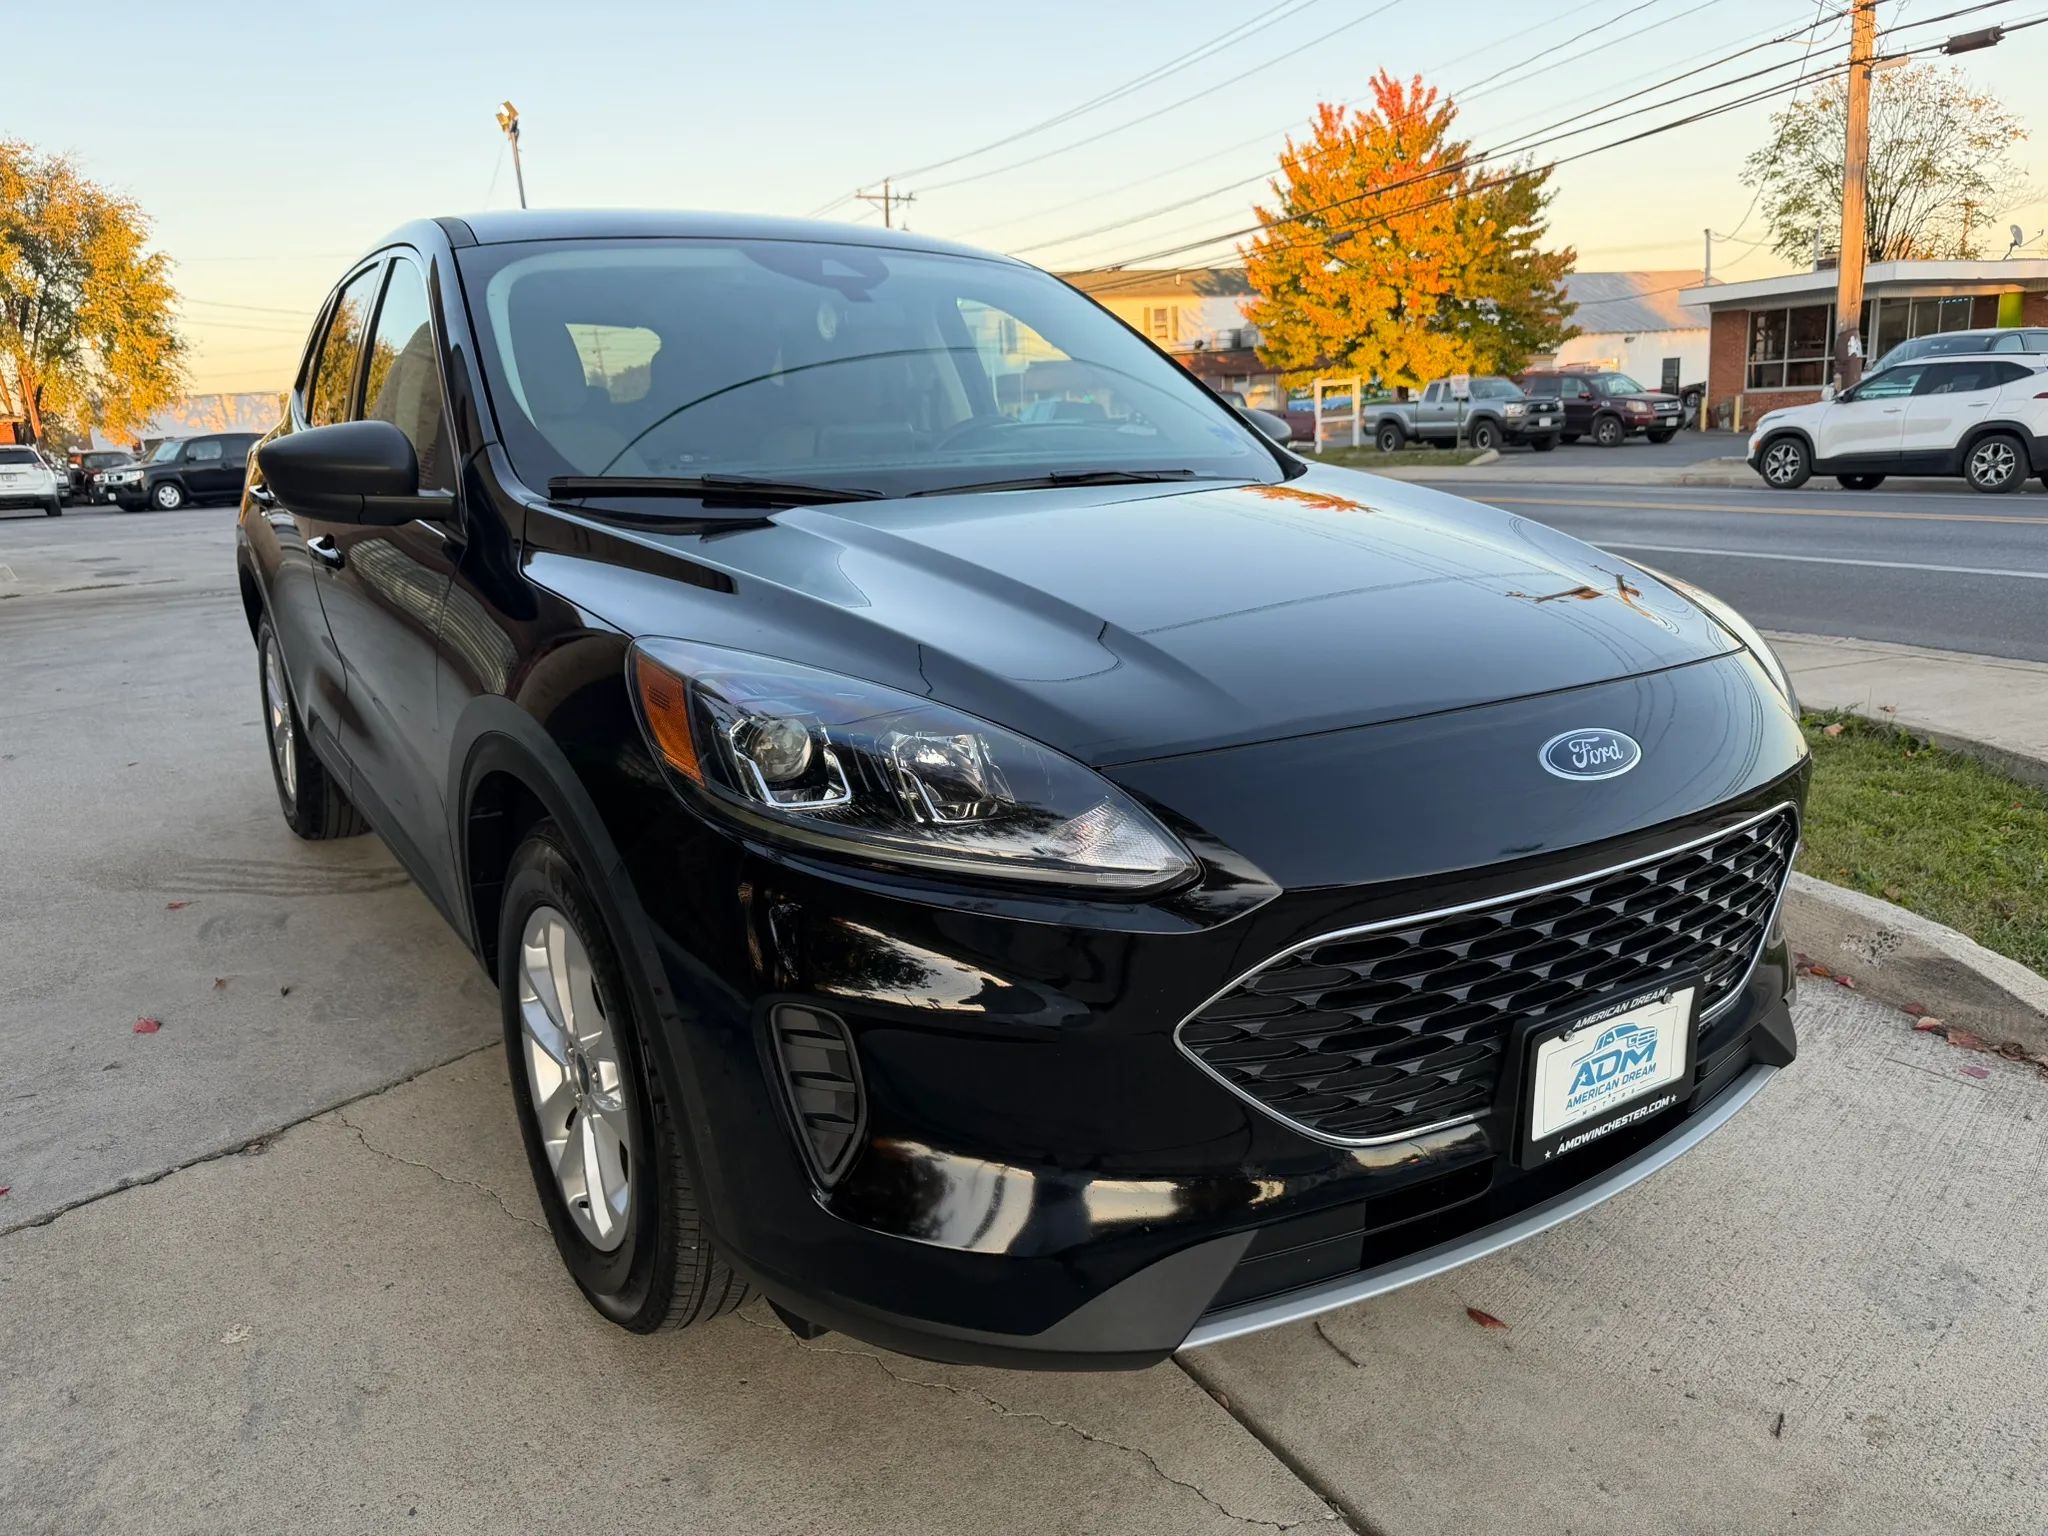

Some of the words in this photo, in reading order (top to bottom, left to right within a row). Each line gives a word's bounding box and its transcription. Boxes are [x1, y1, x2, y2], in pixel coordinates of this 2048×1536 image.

[1568, 736, 1624, 769] Ford
[1572, 1001, 1630, 1030] AMERICAN
[1629, 987, 1668, 1008] DREAM
[1565, 1077, 1620, 1111] AMERICAN
[1621, 1062, 1657, 1085] DREAM
[1567, 1039, 1658, 1096] ADM
[1556, 1095, 1670, 1155] AMDWINCHESTER.COM
